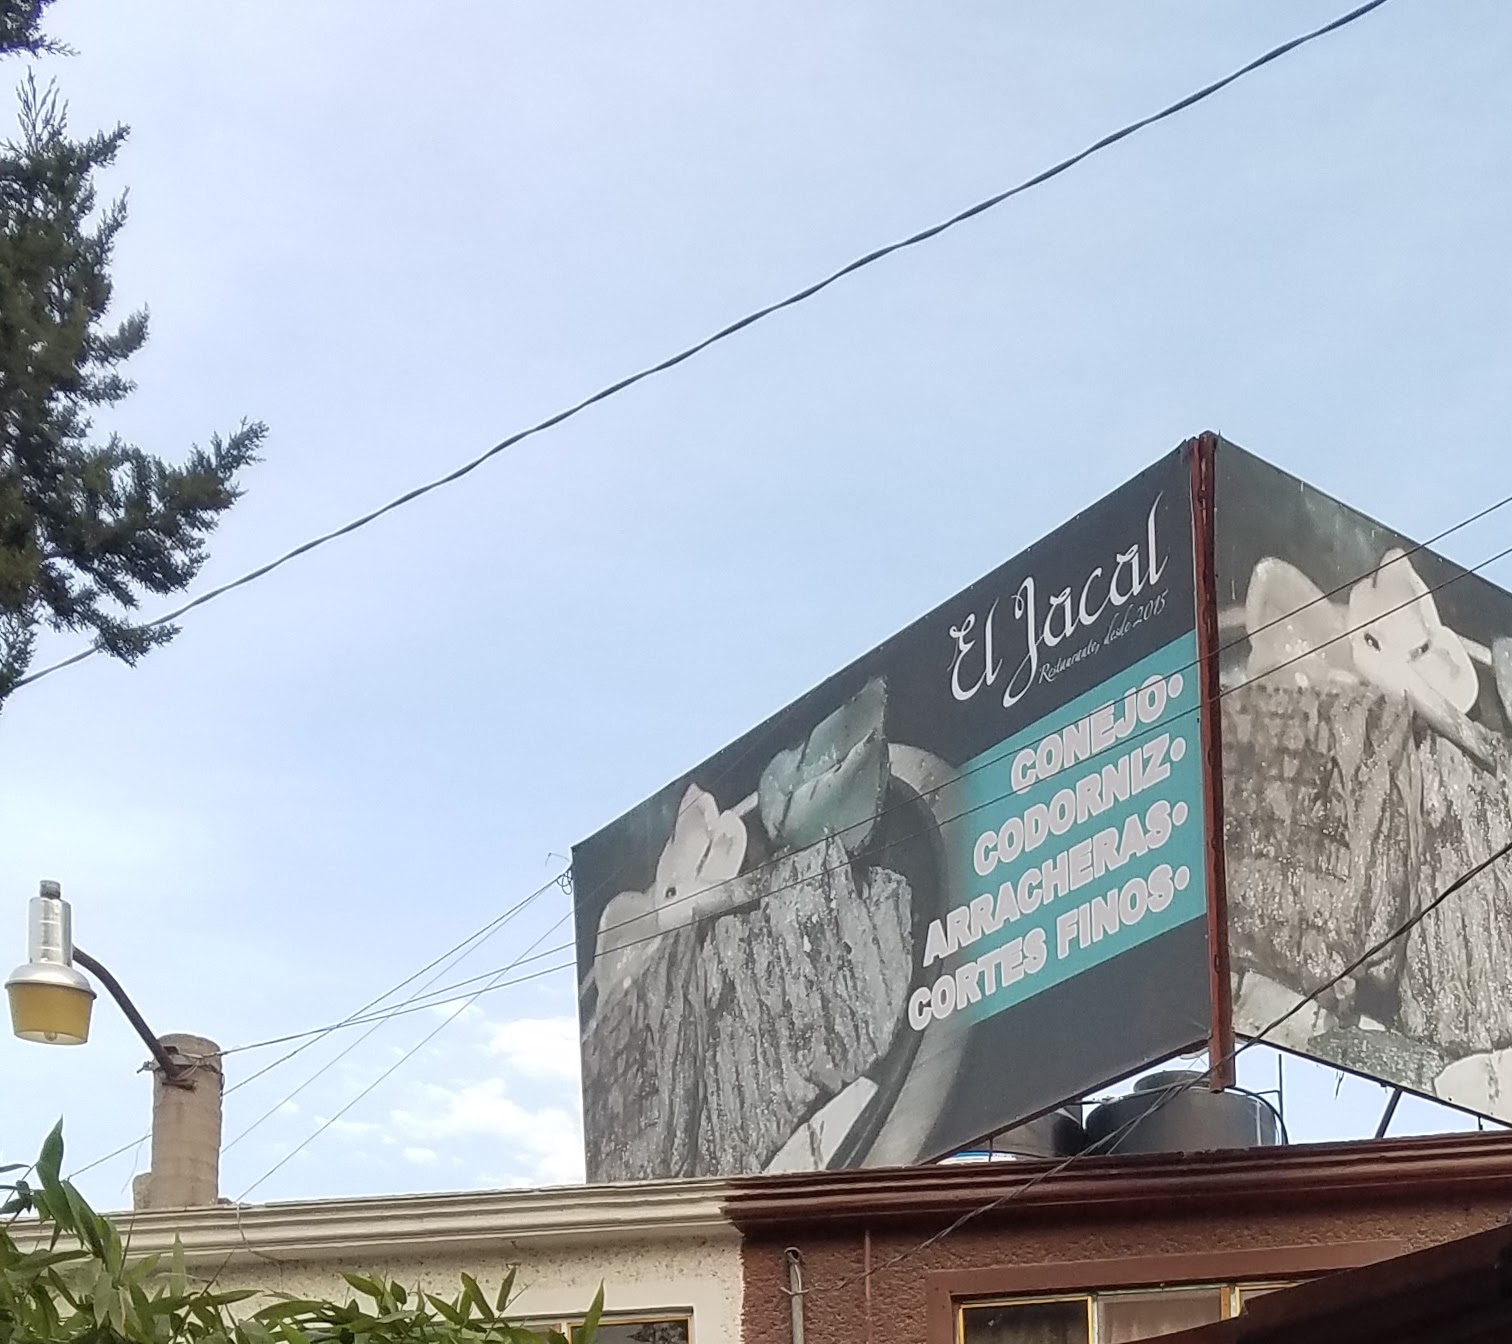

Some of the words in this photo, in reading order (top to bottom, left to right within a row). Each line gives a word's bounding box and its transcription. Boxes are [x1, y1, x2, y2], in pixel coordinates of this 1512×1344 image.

[948, 597, 1003, 700] El
[1003, 490, 1168, 708] Jacal
[1131, 588, 1168, 624] 2015
[973, 732, 1171, 877] CODORNIZ
[1010, 674, 1167, 795] CONEJO
[907, 922, 1047, 1031] CORTES
[1057, 872, 1175, 958] FINOS
[922, 806, 1172, 967] ARRACHERAS
